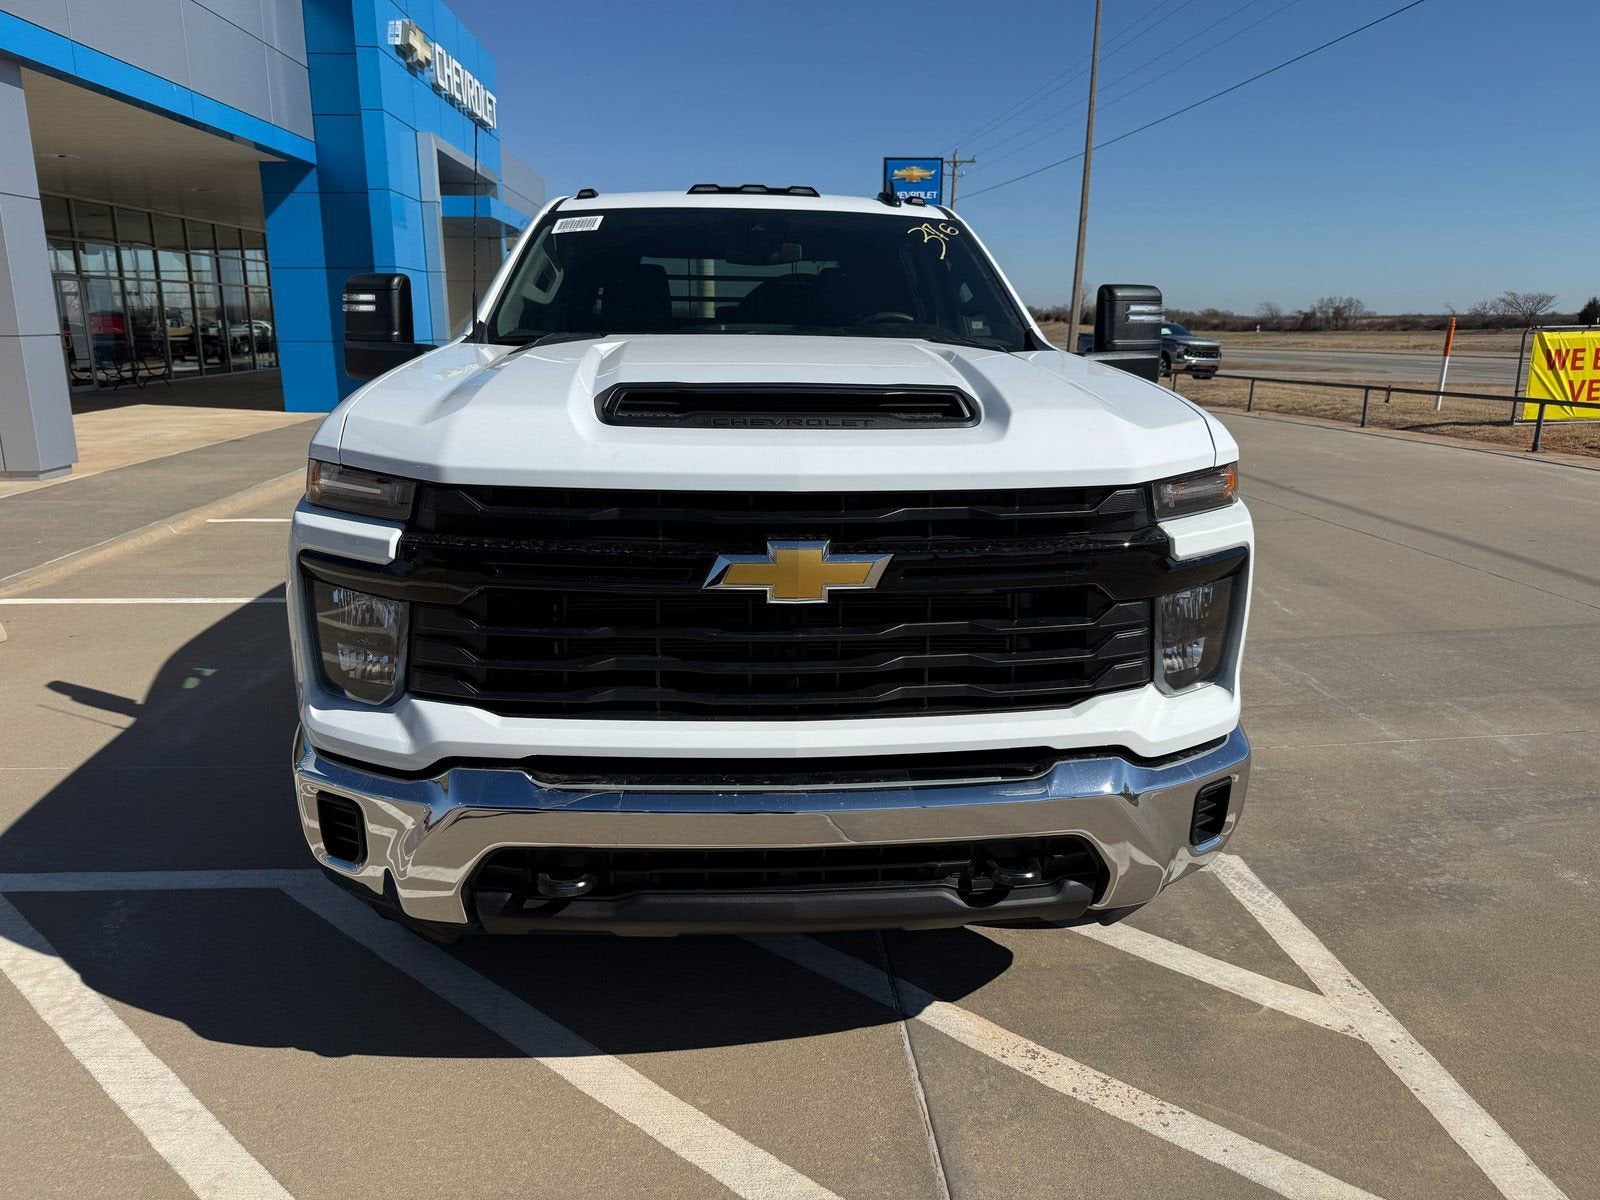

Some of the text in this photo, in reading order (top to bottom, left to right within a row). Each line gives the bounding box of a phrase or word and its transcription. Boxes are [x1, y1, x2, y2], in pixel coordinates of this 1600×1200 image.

[433, 42, 497, 130] CHEVROLET
[896, 191, 938, 199] EVROLET
[1545, 348, 1587, 371] WE
[711, 417, 875, 427] CHEVROLET
